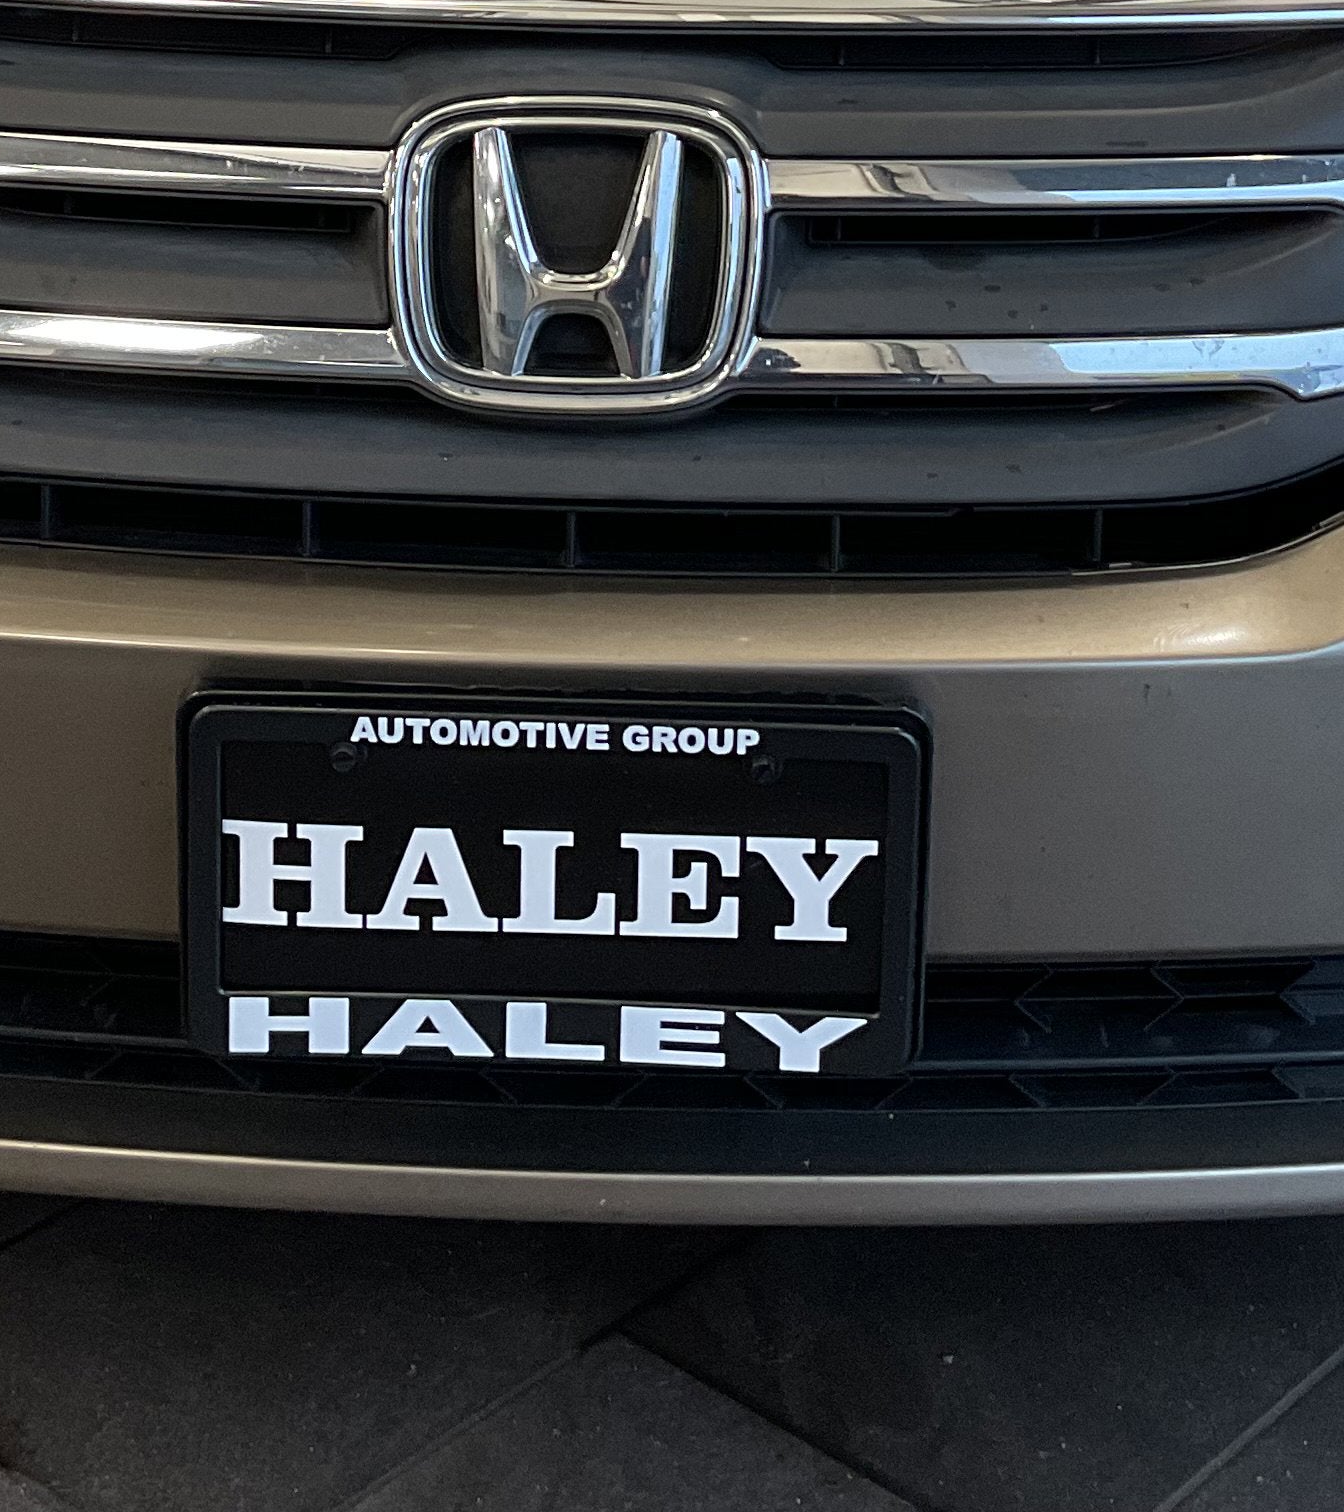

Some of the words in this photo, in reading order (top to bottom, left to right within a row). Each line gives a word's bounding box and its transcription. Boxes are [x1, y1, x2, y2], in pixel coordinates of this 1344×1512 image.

[350, 716, 610, 751] AUTOMOTIVE
[622, 724, 761, 756] GROUP
[222, 818, 879, 942] HALEY
[228, 996, 868, 1073] HALEY
